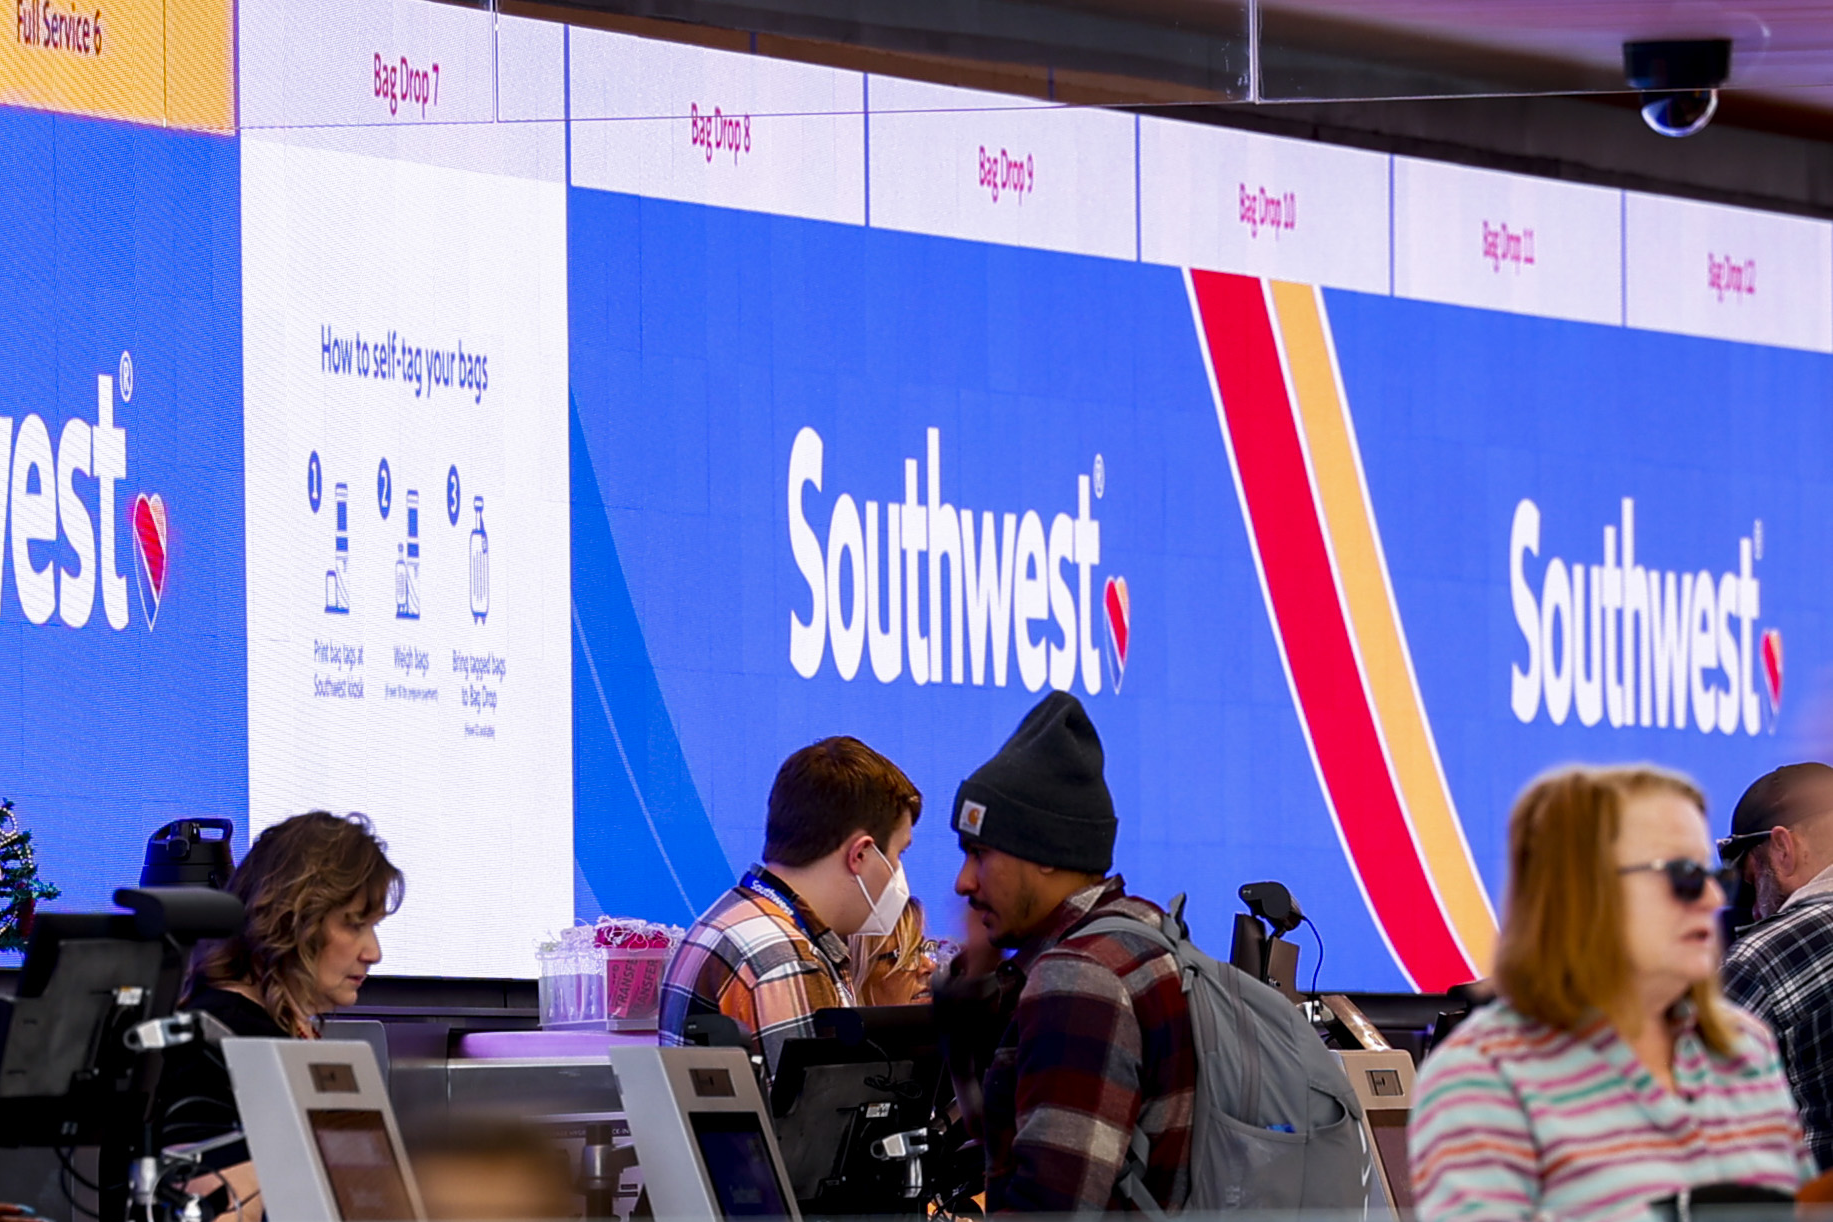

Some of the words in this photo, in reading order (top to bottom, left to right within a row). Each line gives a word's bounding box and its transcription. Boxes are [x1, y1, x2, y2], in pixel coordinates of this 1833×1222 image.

[16, 0, 41, 46] Full
[43, 0, 90, 54] Service
[93, 8, 103, 56] 6
[373, 51, 398, 117] Bag
[400, 55, 430, 121] Drop
[432, 62, 440, 107] 7
[691, 102, 713, 164] Bag
[714, 105, 742, 167] Drop
[743, 111, 752, 154] 8
[978, 144, 999, 204] Bag
[1000, 147, 1026, 207] Drop
[1026, 152, 1034, 194] 9
[1238, 182, 1258, 239] Bag
[1259, 185, 1282, 242] Drop
[1283, 191, 1297, 231] 10
[1482, 219, 1499, 273] Bag
[1500, 222, 1522, 276] Drop
[1522, 228, 1535, 266] 11
[1707, 251, 1723, 304] Bag
[1724, 253, 1743, 305] Drop
[321, 322, 353, 375] How
[355, 331, 370, 378] to
[372, 329, 423, 400] self-tag
[425, 347, 456, 399] your
[458, 338, 489, 405] bags
[1509, 496, 1762, 737] Southwest
[749, 879, 795, 916] Southwest
[614, 958, 639, 1009] TRANSFE
